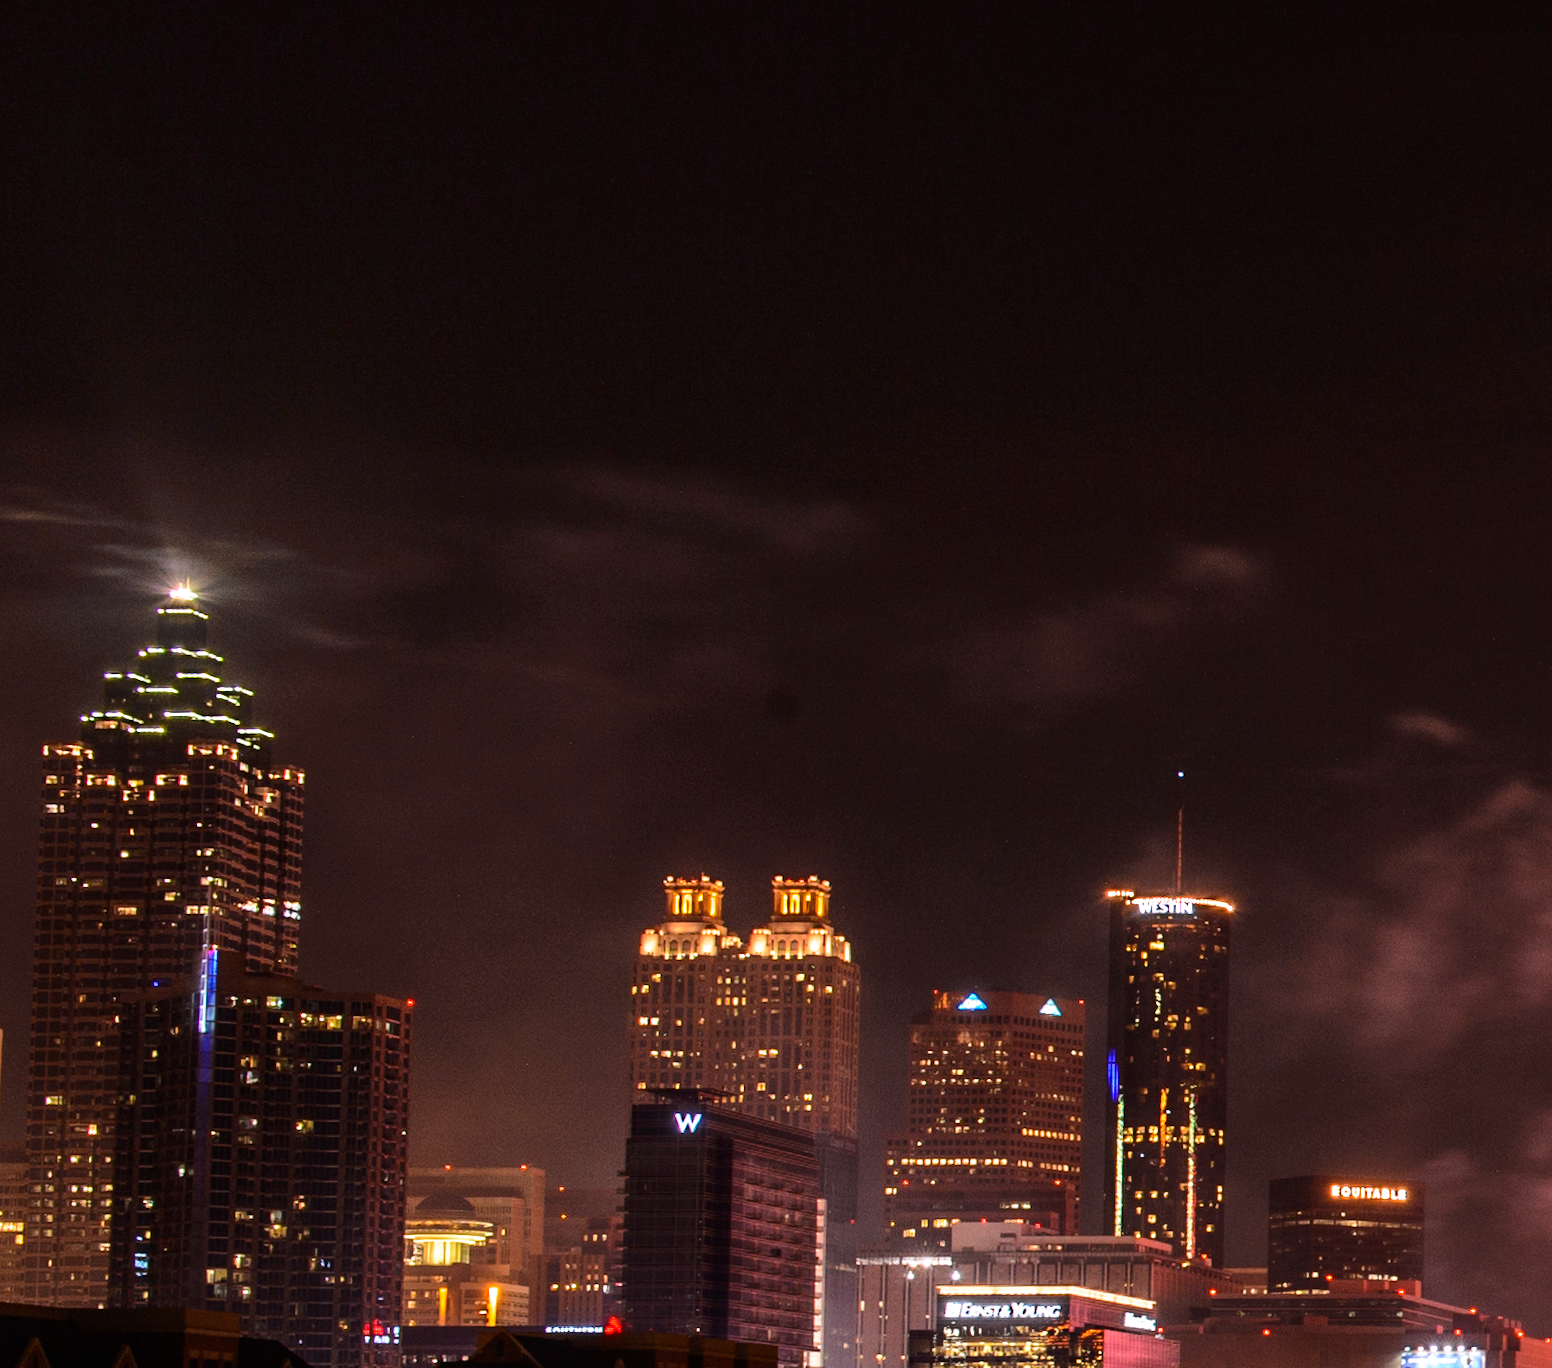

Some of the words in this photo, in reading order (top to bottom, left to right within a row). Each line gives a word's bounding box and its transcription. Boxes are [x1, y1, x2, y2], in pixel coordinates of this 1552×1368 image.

[1138, 899, 1194, 914] WESTIN
[673, 1112, 703, 1134] W
[1331, 1185, 1407, 1200] EQUITABLE
